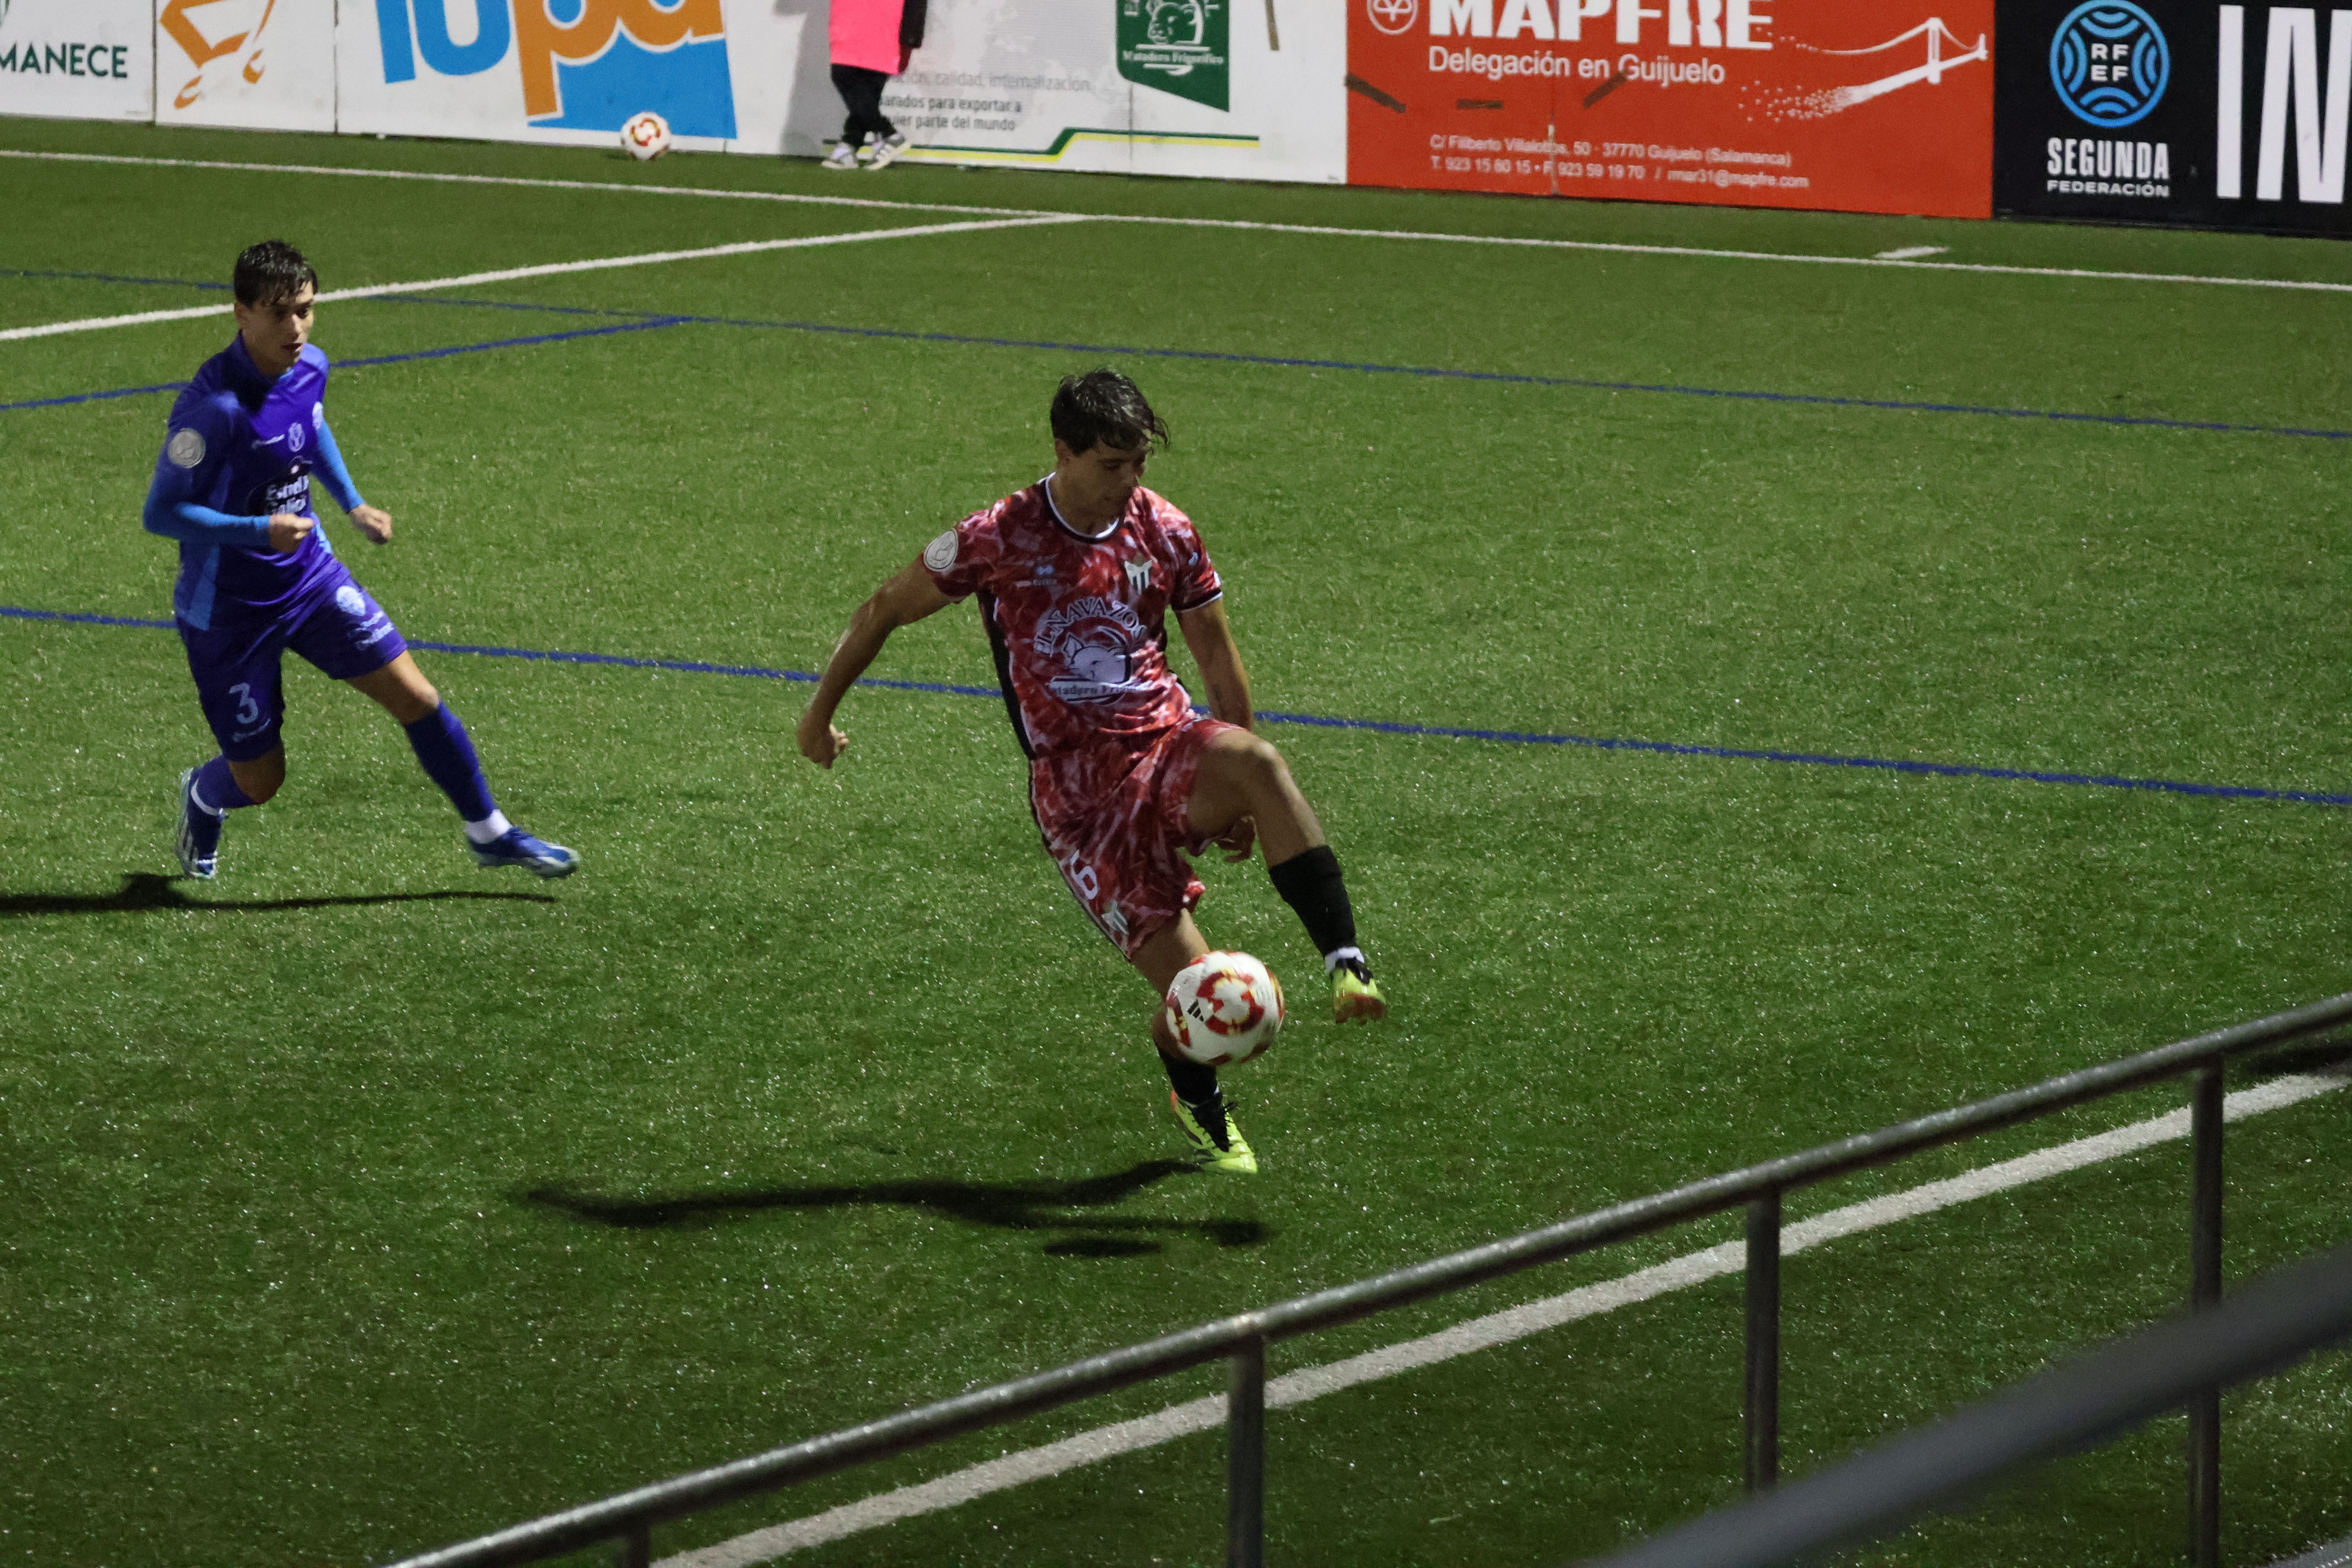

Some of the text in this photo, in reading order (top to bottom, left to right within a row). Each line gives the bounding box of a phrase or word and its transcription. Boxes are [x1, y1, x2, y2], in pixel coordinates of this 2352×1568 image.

[1429, 0, 1773, 49] MAPFRE
[1429, 45, 1725, 88] Delegación en Guijuelo
[951, 116, 970, 129] del
[973, 118, 1016, 131] mundo
[1648, 144, 1703, 162] Guijuelo
[2047, 137, 2169, 180] SEGUNDA
[2047, 180, 2170, 197] FEDERACIÓN
[229, 682, 259, 724] 3
[1070, 850, 1098, 900] 6
